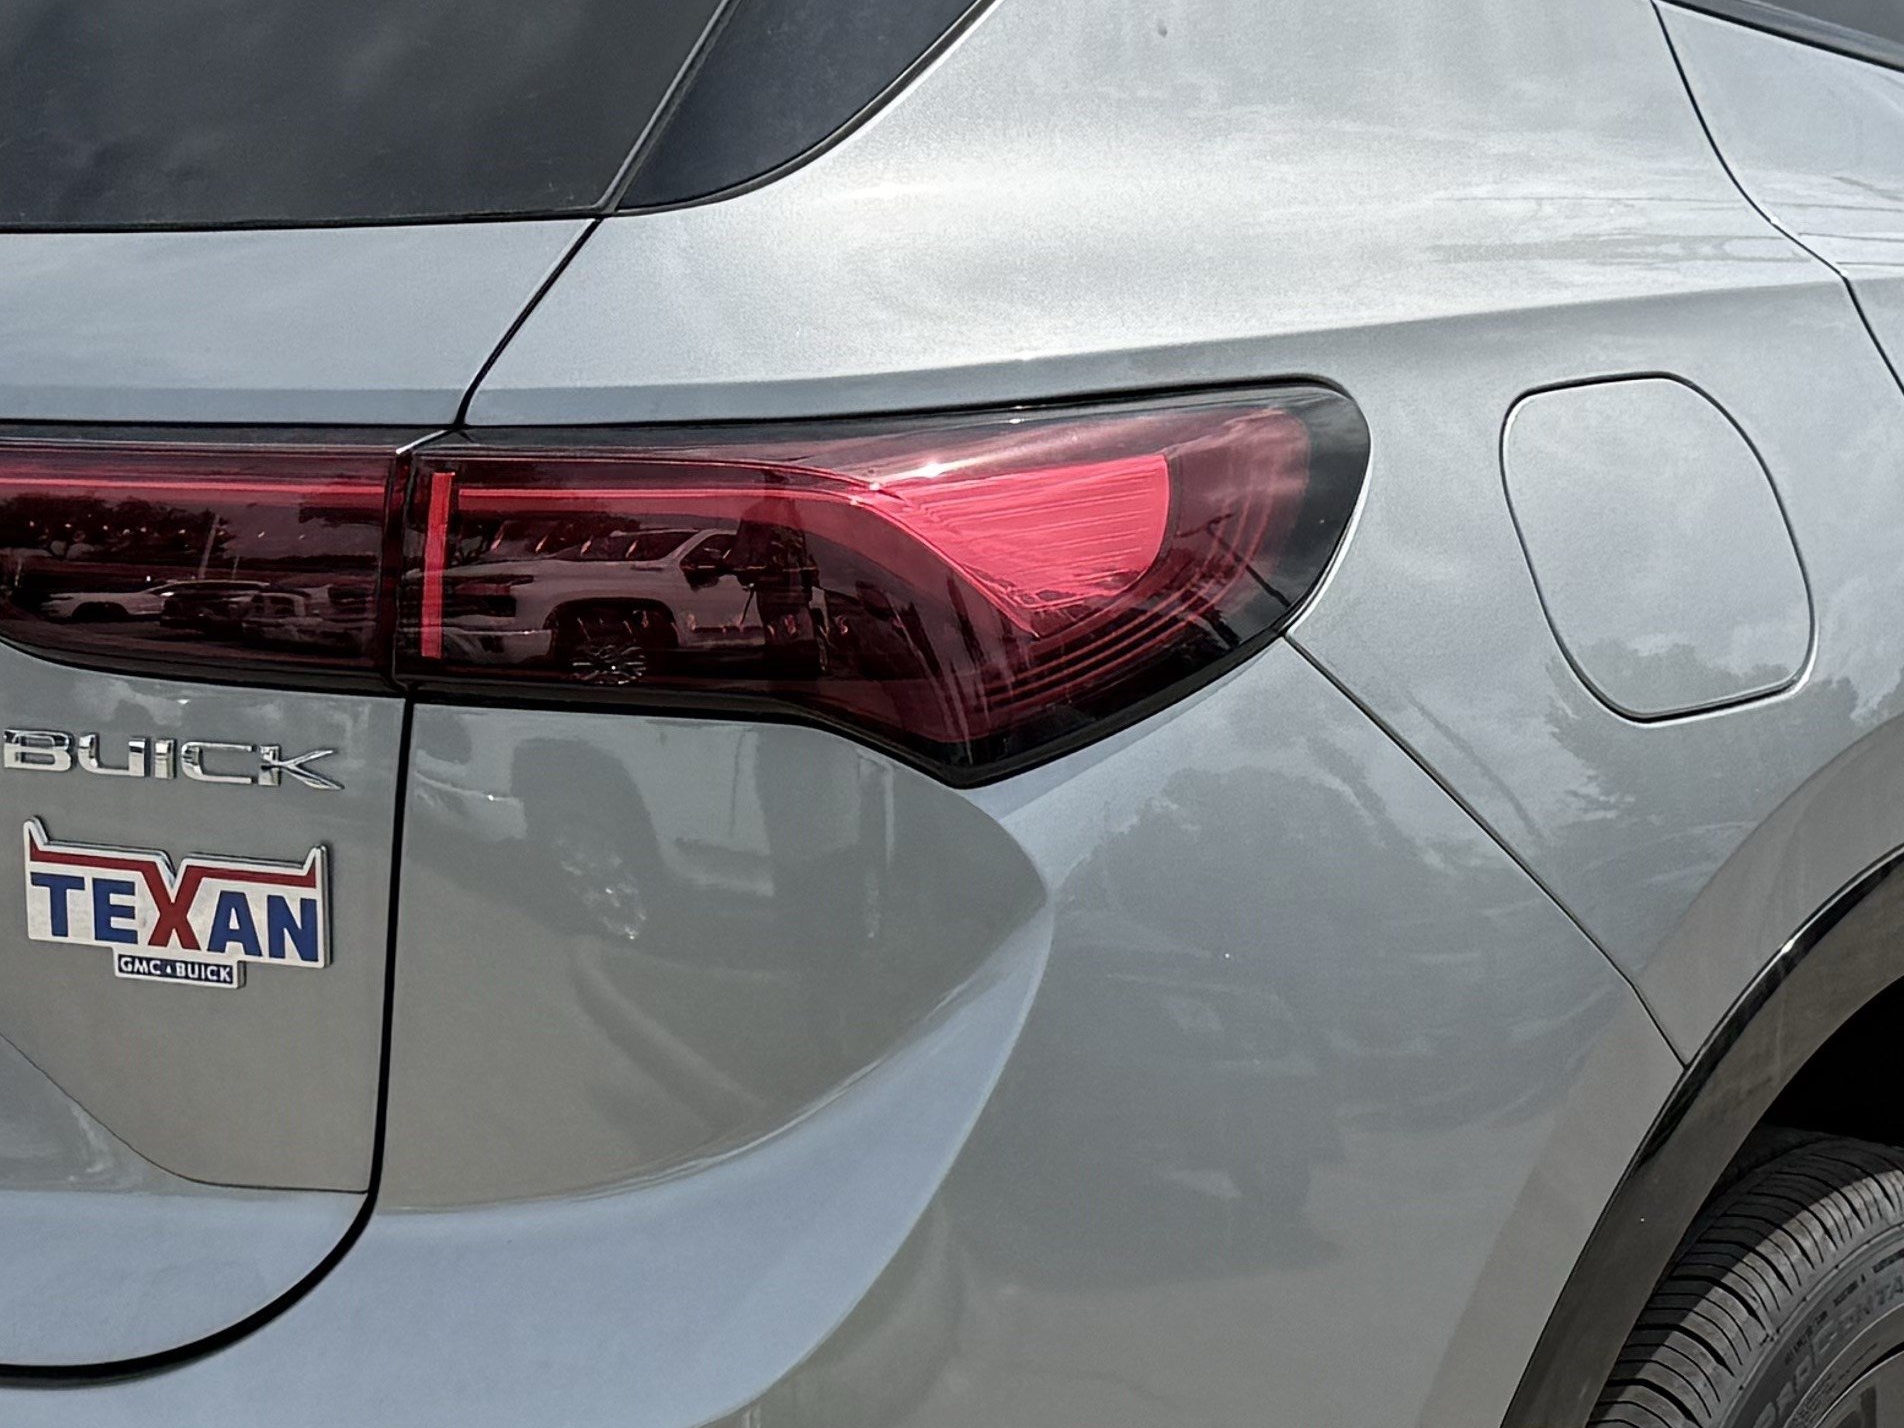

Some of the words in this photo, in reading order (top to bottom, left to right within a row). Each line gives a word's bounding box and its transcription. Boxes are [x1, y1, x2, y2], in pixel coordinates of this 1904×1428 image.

[3, 728, 345, 790] BUICK
[28, 836, 320, 963] TEXAN
[119, 956, 164, 976] GMC
[175, 961, 233, 983] BUICK
